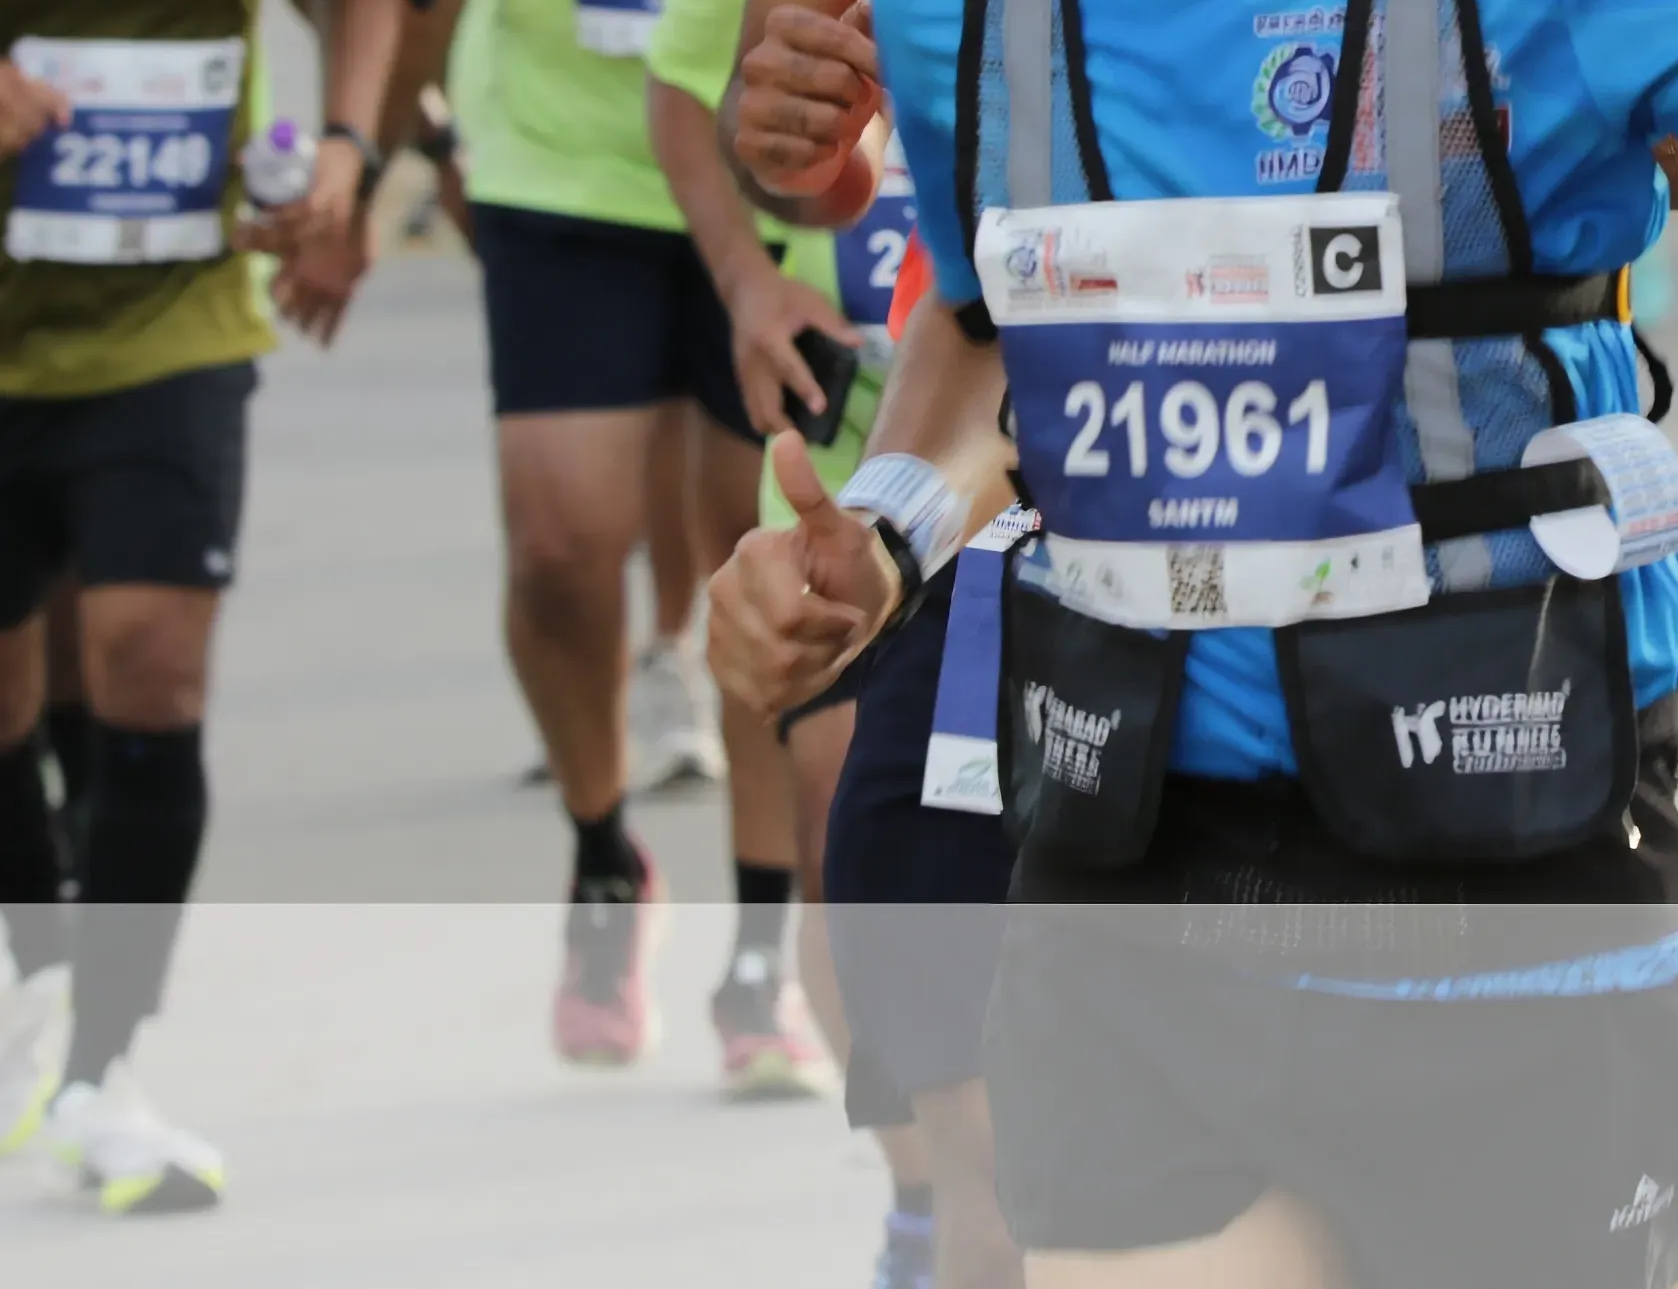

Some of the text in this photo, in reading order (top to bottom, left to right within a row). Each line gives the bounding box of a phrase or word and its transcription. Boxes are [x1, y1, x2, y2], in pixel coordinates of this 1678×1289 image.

[1321, 233, 1365, 289] C
[1108, 337, 1277, 366] HALF MARATHON
[1063, 380, 1330, 478] 21961
